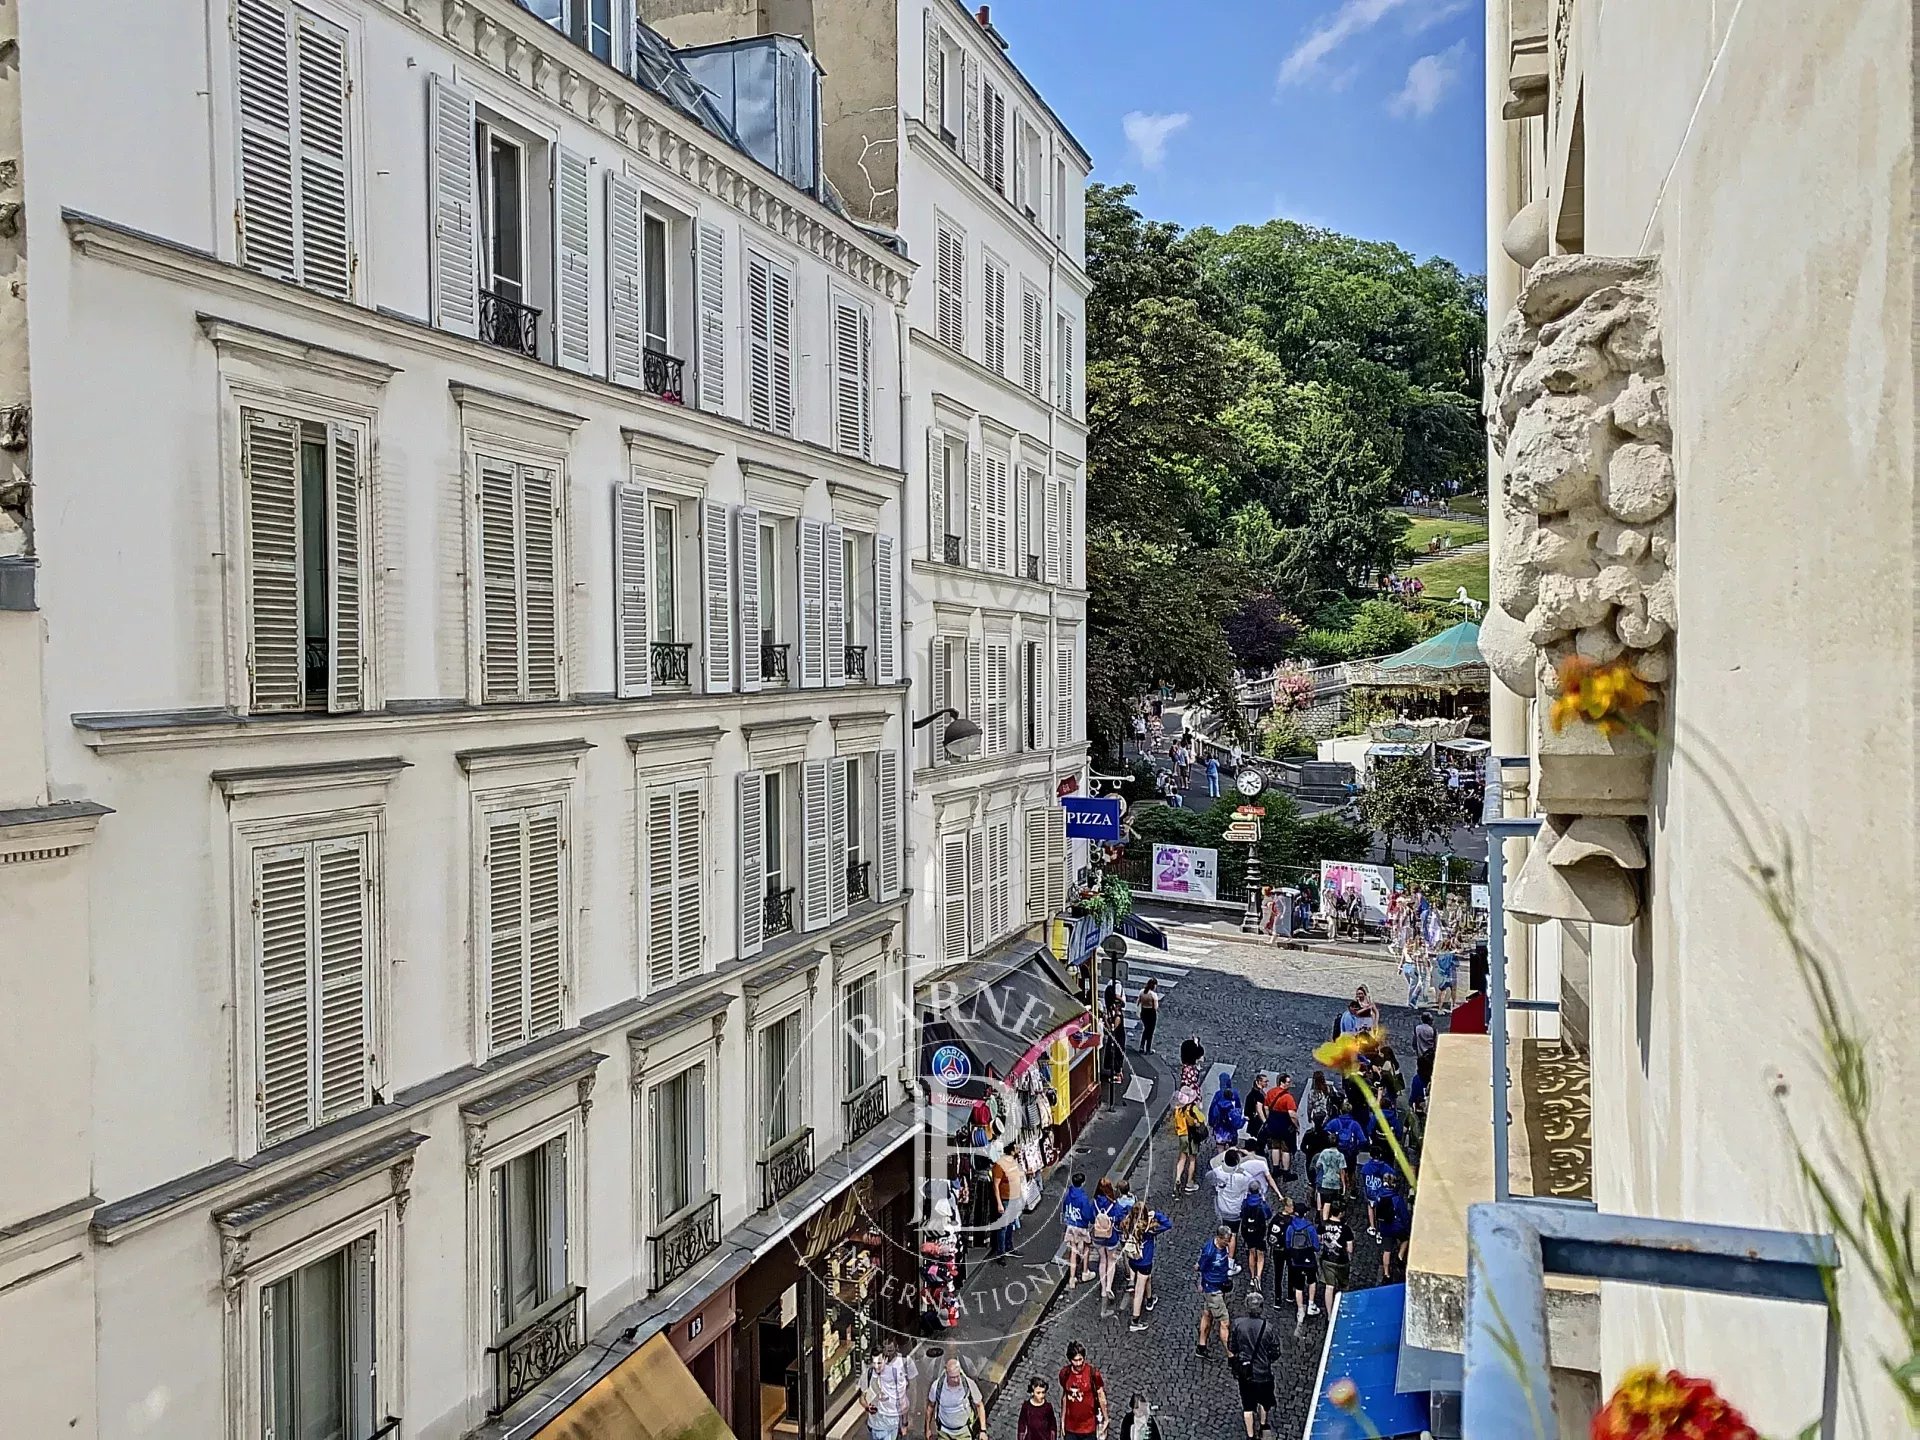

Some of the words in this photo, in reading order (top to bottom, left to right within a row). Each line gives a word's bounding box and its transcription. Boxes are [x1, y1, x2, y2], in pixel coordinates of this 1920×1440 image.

[1066, 811, 1113, 826] PIZZA
[941, 1048, 965, 1062] PARIS
[691, 1317, 702, 1338] 13
